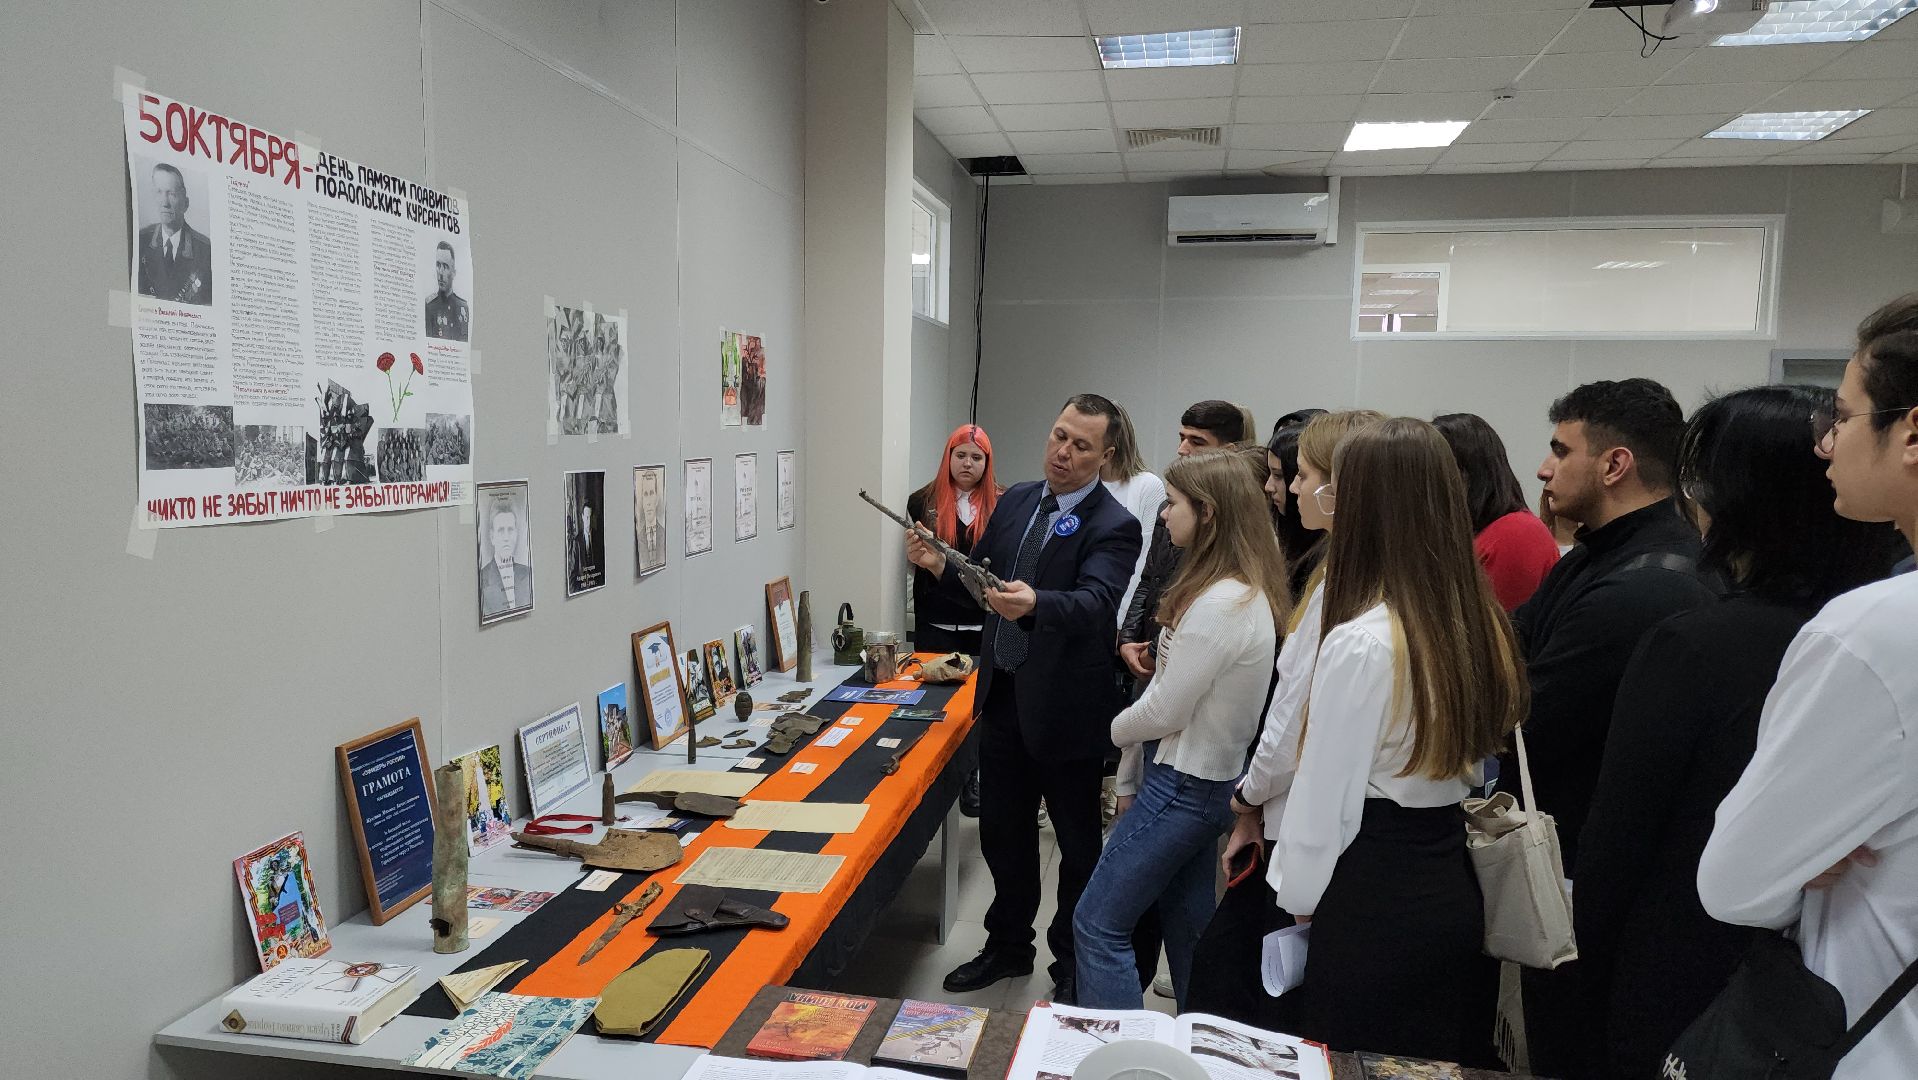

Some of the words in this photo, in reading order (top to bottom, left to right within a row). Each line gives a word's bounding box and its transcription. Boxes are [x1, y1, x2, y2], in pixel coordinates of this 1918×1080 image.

[138, 95, 163, 143] 5
[315, 151, 354, 181] ДЕНЬ
[358, 165, 407, 197] ПАМЯТИ
[315, 174, 402, 217] ПОДОЛЬСКИХ
[406, 201, 460, 235] КУРСАНТОВ
[147, 496, 196, 521] НИКТО
[202, 494, 223, 519] НЕ
[280, 489, 322, 513] НИЧТО
[324, 487, 341, 510] НЕ
[362, 766, 412, 797] ГРАМОТА
